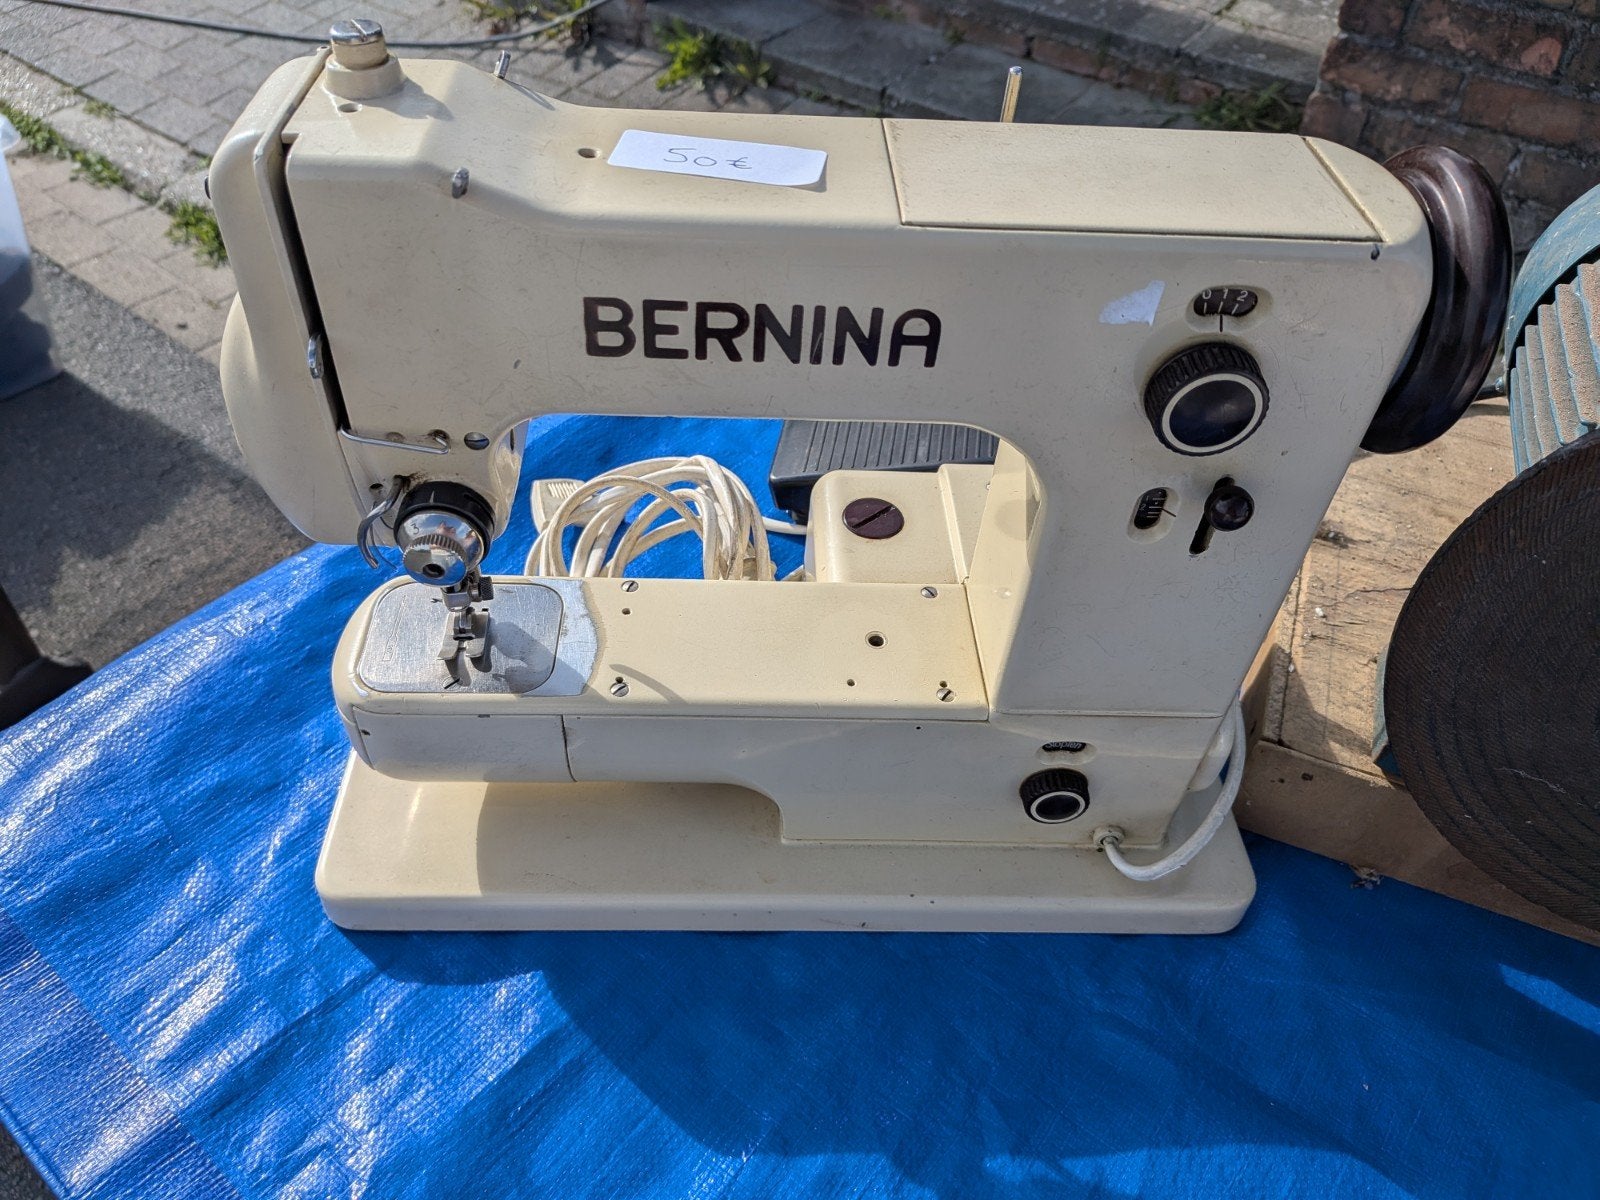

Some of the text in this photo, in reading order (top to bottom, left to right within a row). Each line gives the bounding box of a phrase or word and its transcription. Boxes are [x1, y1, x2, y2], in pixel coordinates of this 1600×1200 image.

[1237, 290, 1248, 301] 2
[583, 296, 942, 368] BERNINA
[411, 523, 420, 535] 3
